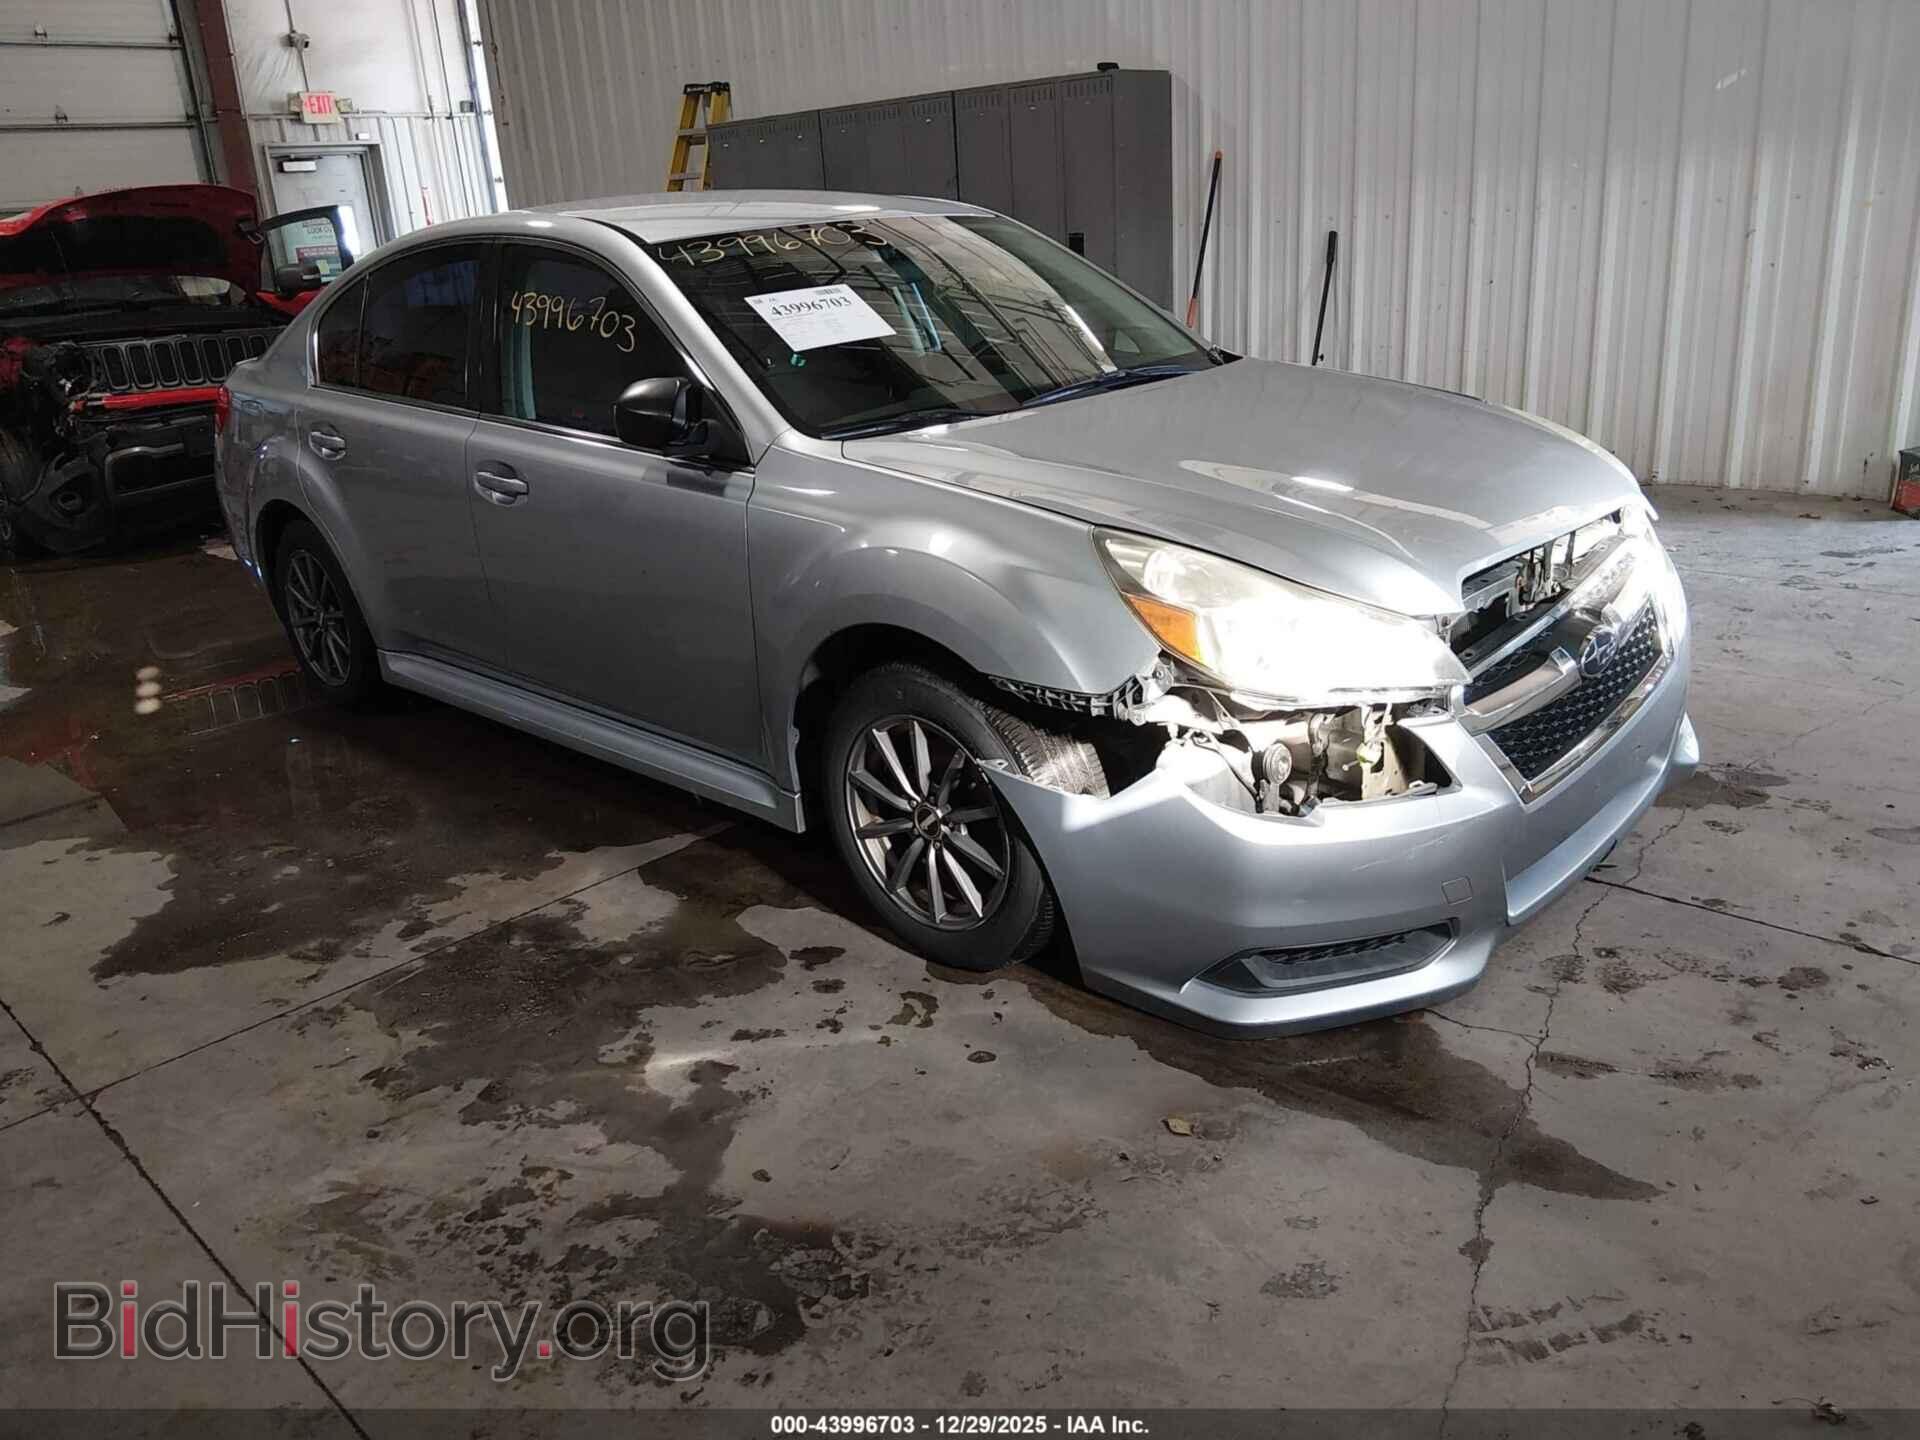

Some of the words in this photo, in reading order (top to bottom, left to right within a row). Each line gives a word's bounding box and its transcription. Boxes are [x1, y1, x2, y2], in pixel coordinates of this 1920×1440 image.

[308, 94, 332, 114] EXIT
[658, 222, 888, 266] 43996703
[511, 290, 636, 352] 43996703
[770, 296, 852, 317] 43996703
